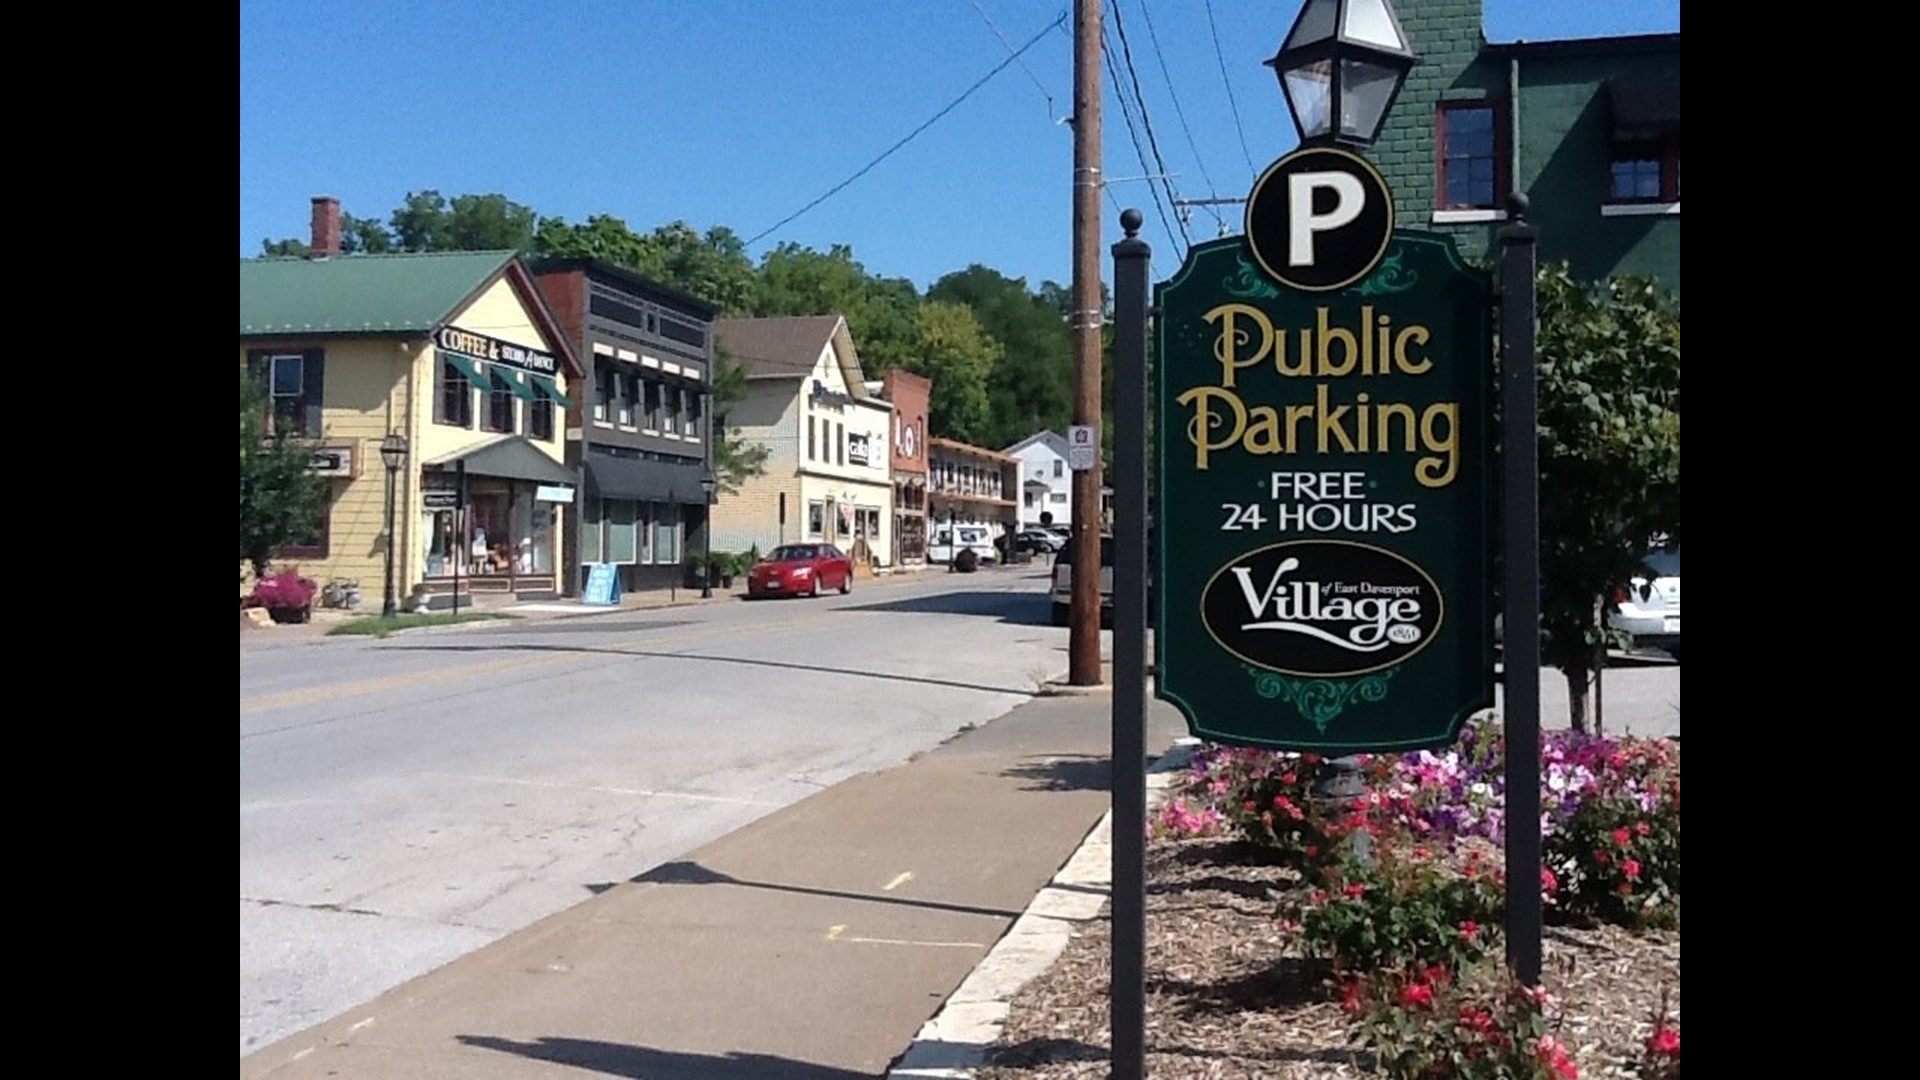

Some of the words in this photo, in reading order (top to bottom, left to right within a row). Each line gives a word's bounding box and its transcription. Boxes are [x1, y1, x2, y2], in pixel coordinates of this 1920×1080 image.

[1288, 170, 1366, 267] P
[441, 329, 487, 357] COFFEE
[488, 340, 500, 360] &
[1201, 303, 1433, 387] Public
[1175, 384, 1460, 488] Parking
[1271, 471, 1366, 501] FREE
[1220, 503, 1267, 531] 24
[1278, 503, 1417, 533] HOURS
[1231, 557, 1421, 644] Village
[1321, 582, 1333, 596] of
[1334, 582, 1358, 594] East
[1360, 581, 1420, 598] Davenport
